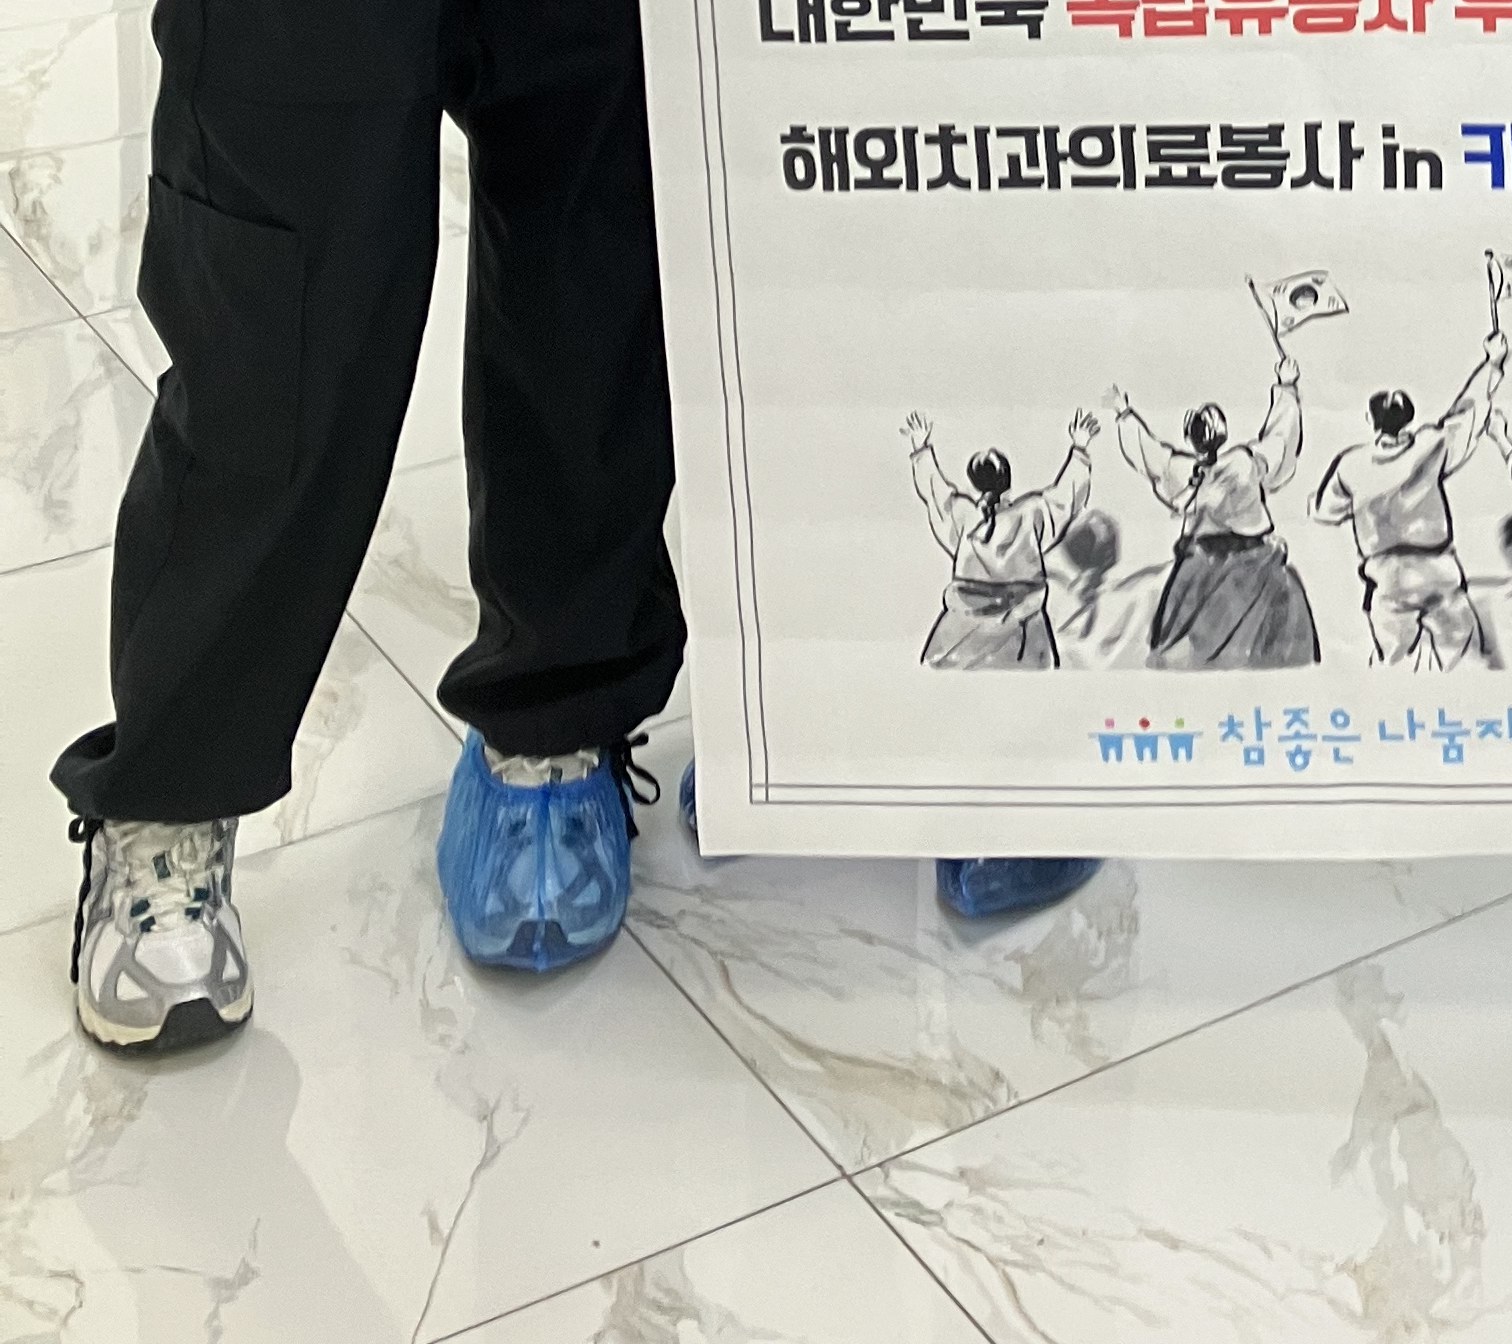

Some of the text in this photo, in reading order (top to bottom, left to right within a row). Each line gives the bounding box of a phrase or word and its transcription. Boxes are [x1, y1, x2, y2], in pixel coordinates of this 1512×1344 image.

[780, 119, 1365, 193] 해외치과의료봉사
[1381, 123, 1443, 191] in
[1218, 705, 1362, 772] 참좋은
